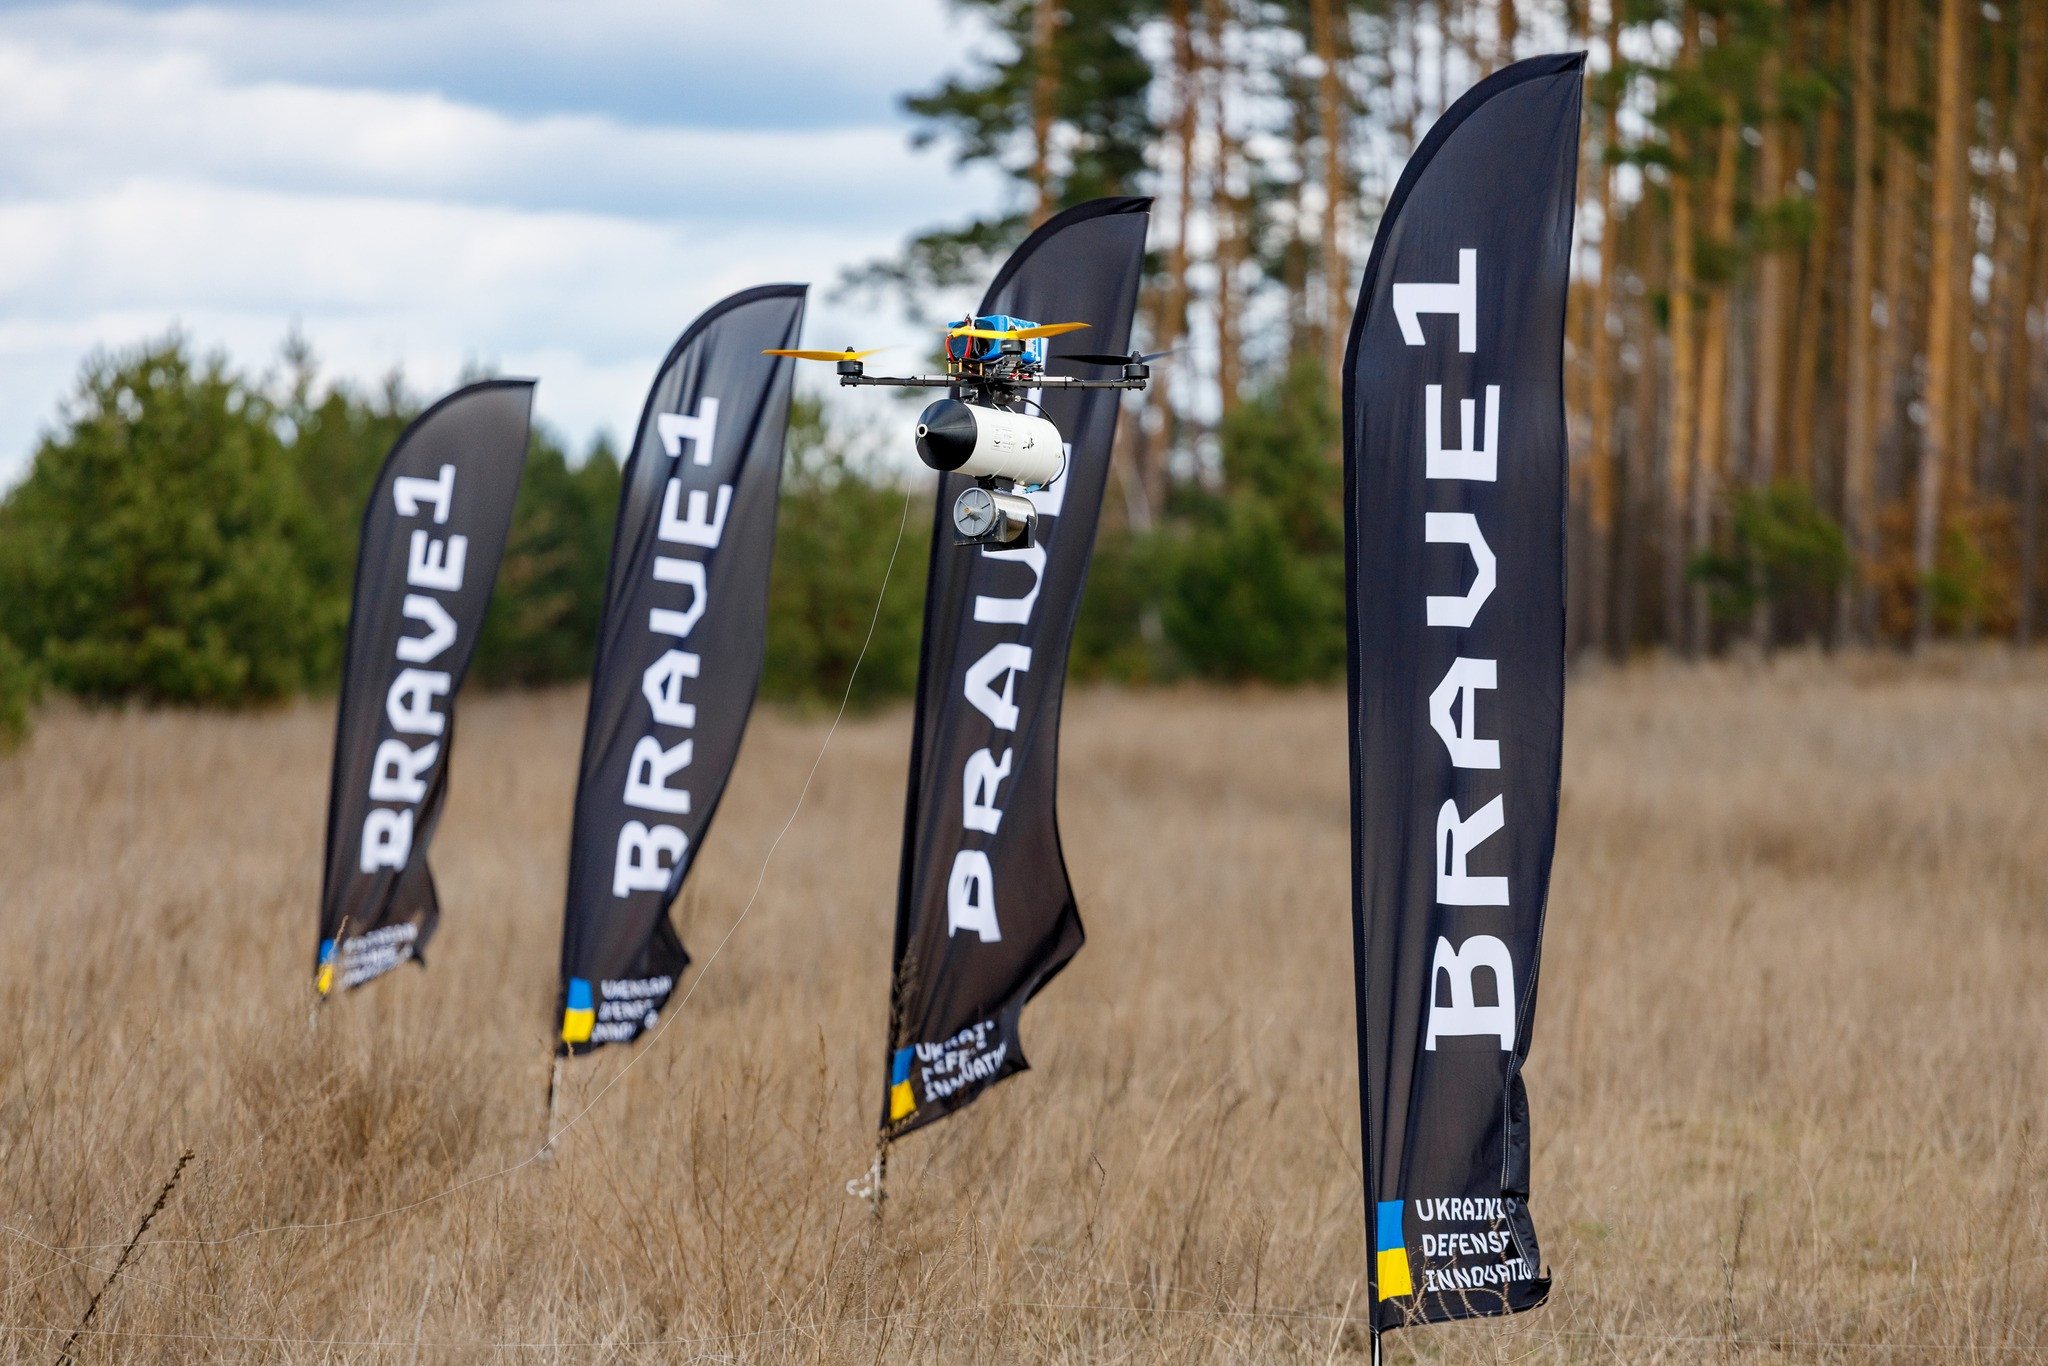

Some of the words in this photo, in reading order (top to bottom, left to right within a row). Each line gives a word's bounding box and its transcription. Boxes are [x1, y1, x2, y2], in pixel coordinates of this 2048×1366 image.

[360, 464, 468, 873] BRAVE1
[612, 397, 733, 898] BRAVE1
[1393, 248, 1516, 1052] BRAVE1
[1425, 1257, 1534, 1293] INNOVATIO
